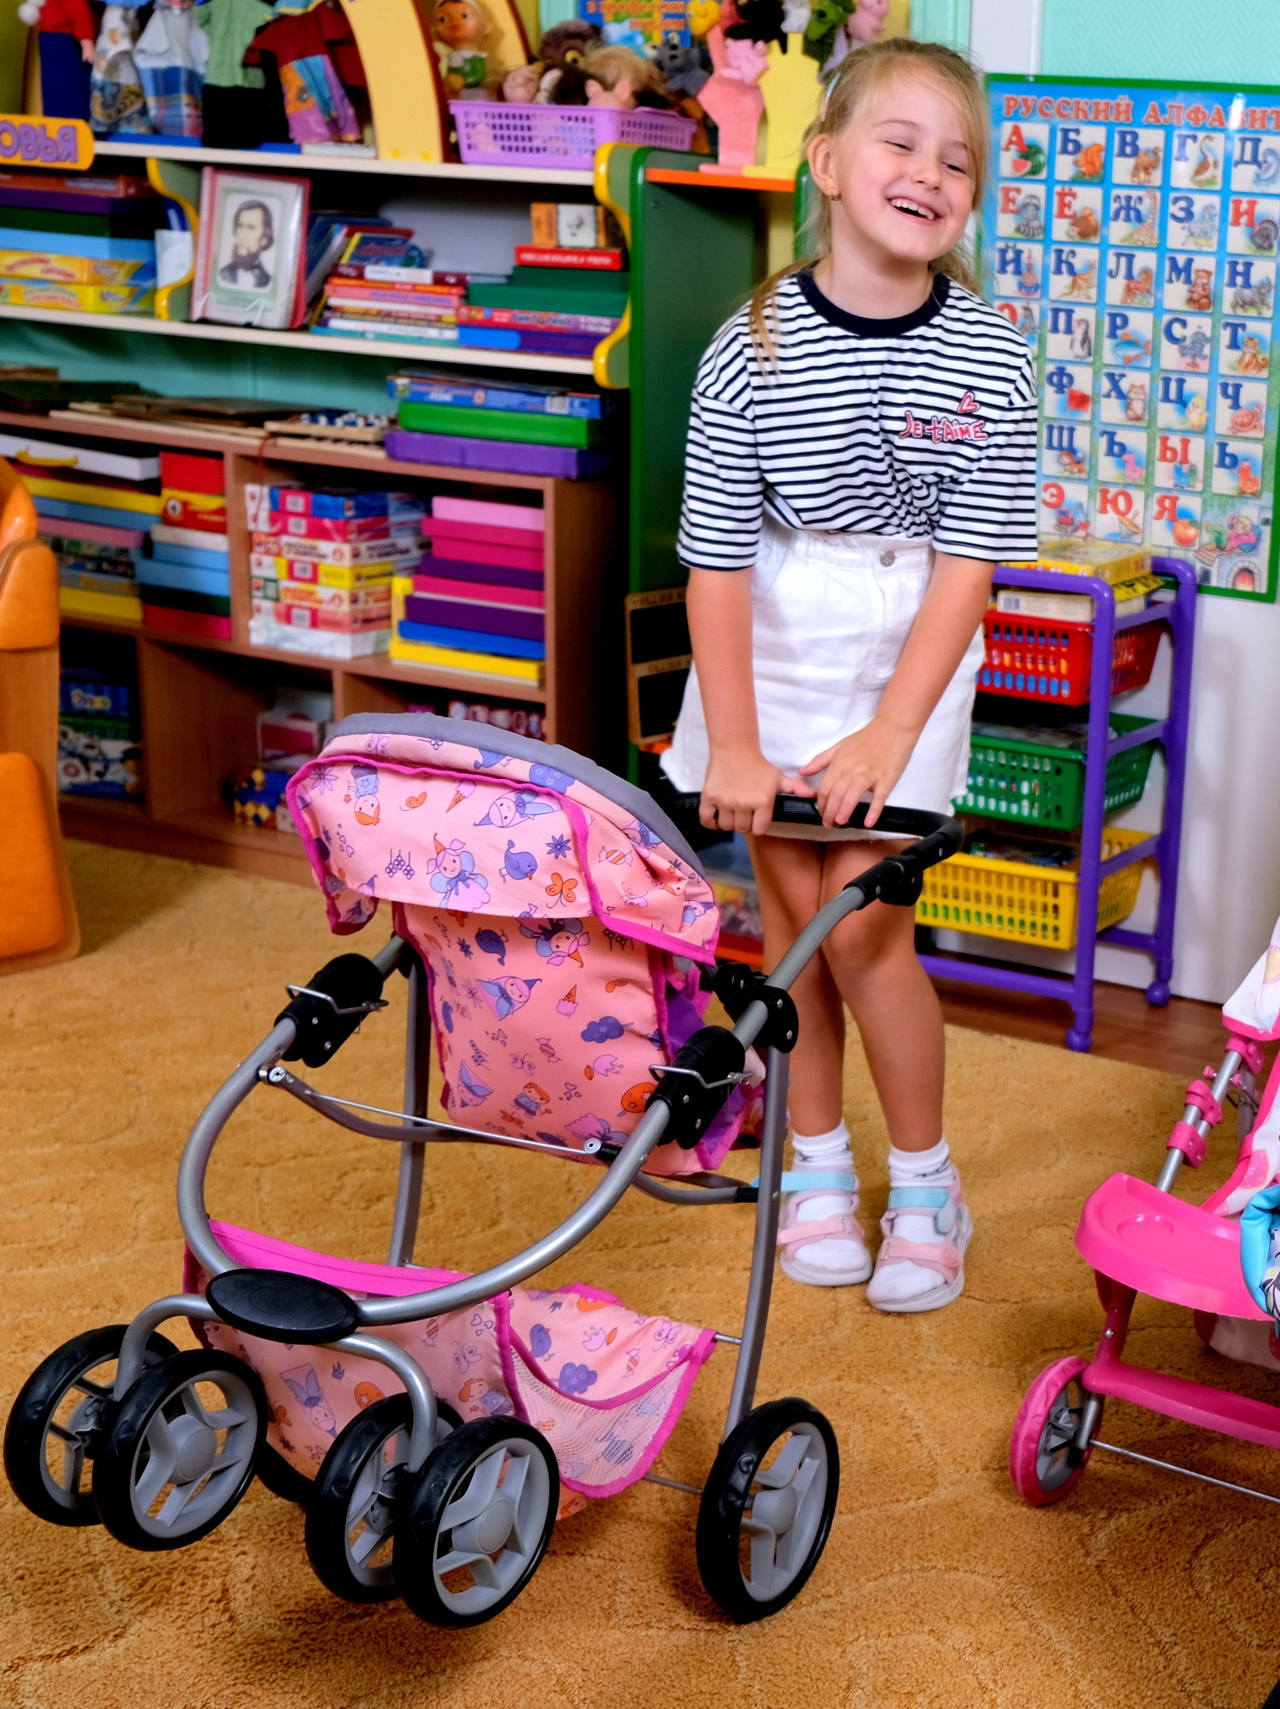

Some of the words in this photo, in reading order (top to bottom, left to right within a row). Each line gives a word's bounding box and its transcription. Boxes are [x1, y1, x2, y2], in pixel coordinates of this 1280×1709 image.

[1002, 94, 1133, 123] РУССКИЙ
[1002, 124, 1028, 152] А
[1058, 128, 1082, 156] Б
[1115, 130, 1140, 158] В
[1174, 131, 1197, 162] Г
[1233, 136, 1263, 169] Д
[1001, 187, 1021, 214] Е
[1055, 187, 1077, 220] Ё
[1111, 194, 1144, 223] Ж
[1170, 196, 1195, 224] З
[1230, 198, 1257, 227] И
[996, 243, 1024, 276] Й
[1052, 248, 1077, 277] К
[1107, 252, 1136, 280] Л
[1166, 256, 1194, 285] М
[1225, 260, 1254, 290] Н
[1050, 307, 1075, 335] П
[1107, 313, 1129, 343] Р
[1163, 317, 1188, 345] С
[1222, 321, 1247, 350] Т
[1045, 366, 1074, 395] Ф
[1103, 372, 1128, 400] Х
[1160, 376, 1187, 407] Ц
[1219, 382, 1243, 410] Ч
[1045, 424, 1077, 455] Щ
[1100, 430, 1127, 458] Ъ
[1157, 435, 1191, 465] Ы
[1216, 441, 1239, 470] Ь
[1042, 483, 1066, 509] Э
[1097, 488, 1134, 515] Ю
[1153, 495, 1180, 522] Я
